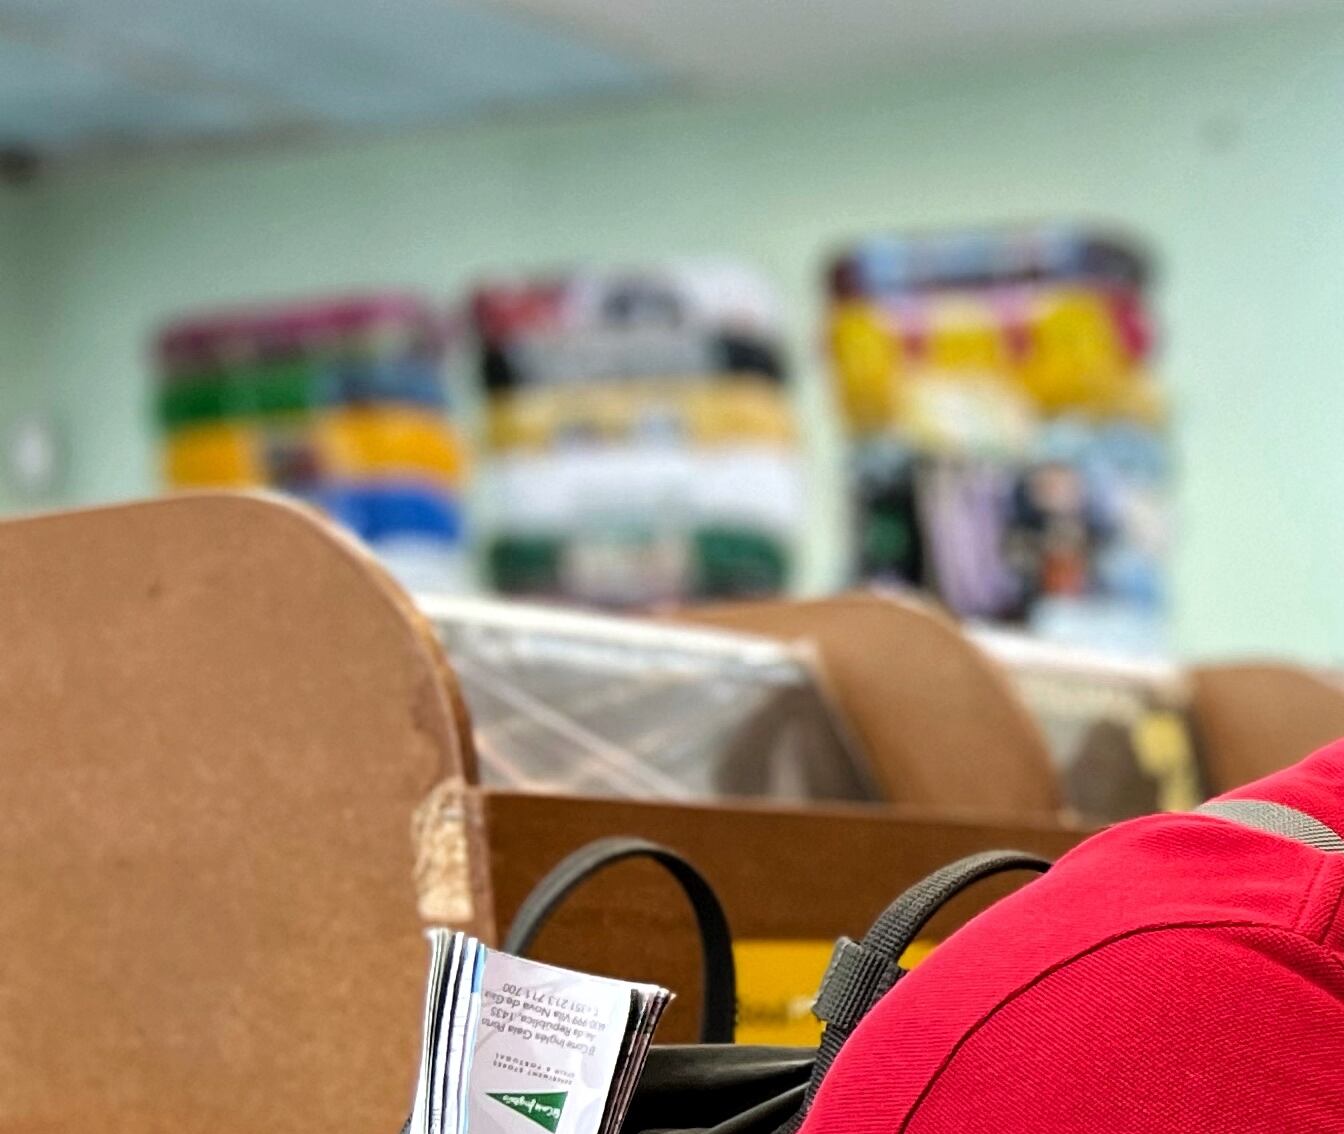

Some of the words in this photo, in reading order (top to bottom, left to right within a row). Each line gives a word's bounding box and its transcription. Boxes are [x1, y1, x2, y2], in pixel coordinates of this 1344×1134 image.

[502, 984, 522, 997] 700
[526, 989, 545, 1003] 711
[506, 997, 520, 1008] de
[548, 996, 568, 1009] 213
[490, 1007, 514, 1021] 1435
[523, 1002, 551, 1018] Nova
[554, 1011, 570, 1023] Vila
[482, 1018, 506, 1033] Porto
[508, 1025, 532, 1040] Gaia
[573, 1029, 583, 1038] da
[535, 1033, 565, 1048] Inglés
[566, 1041, 588, 1054] Corte
[492, 1060, 523, 1073] STORES
